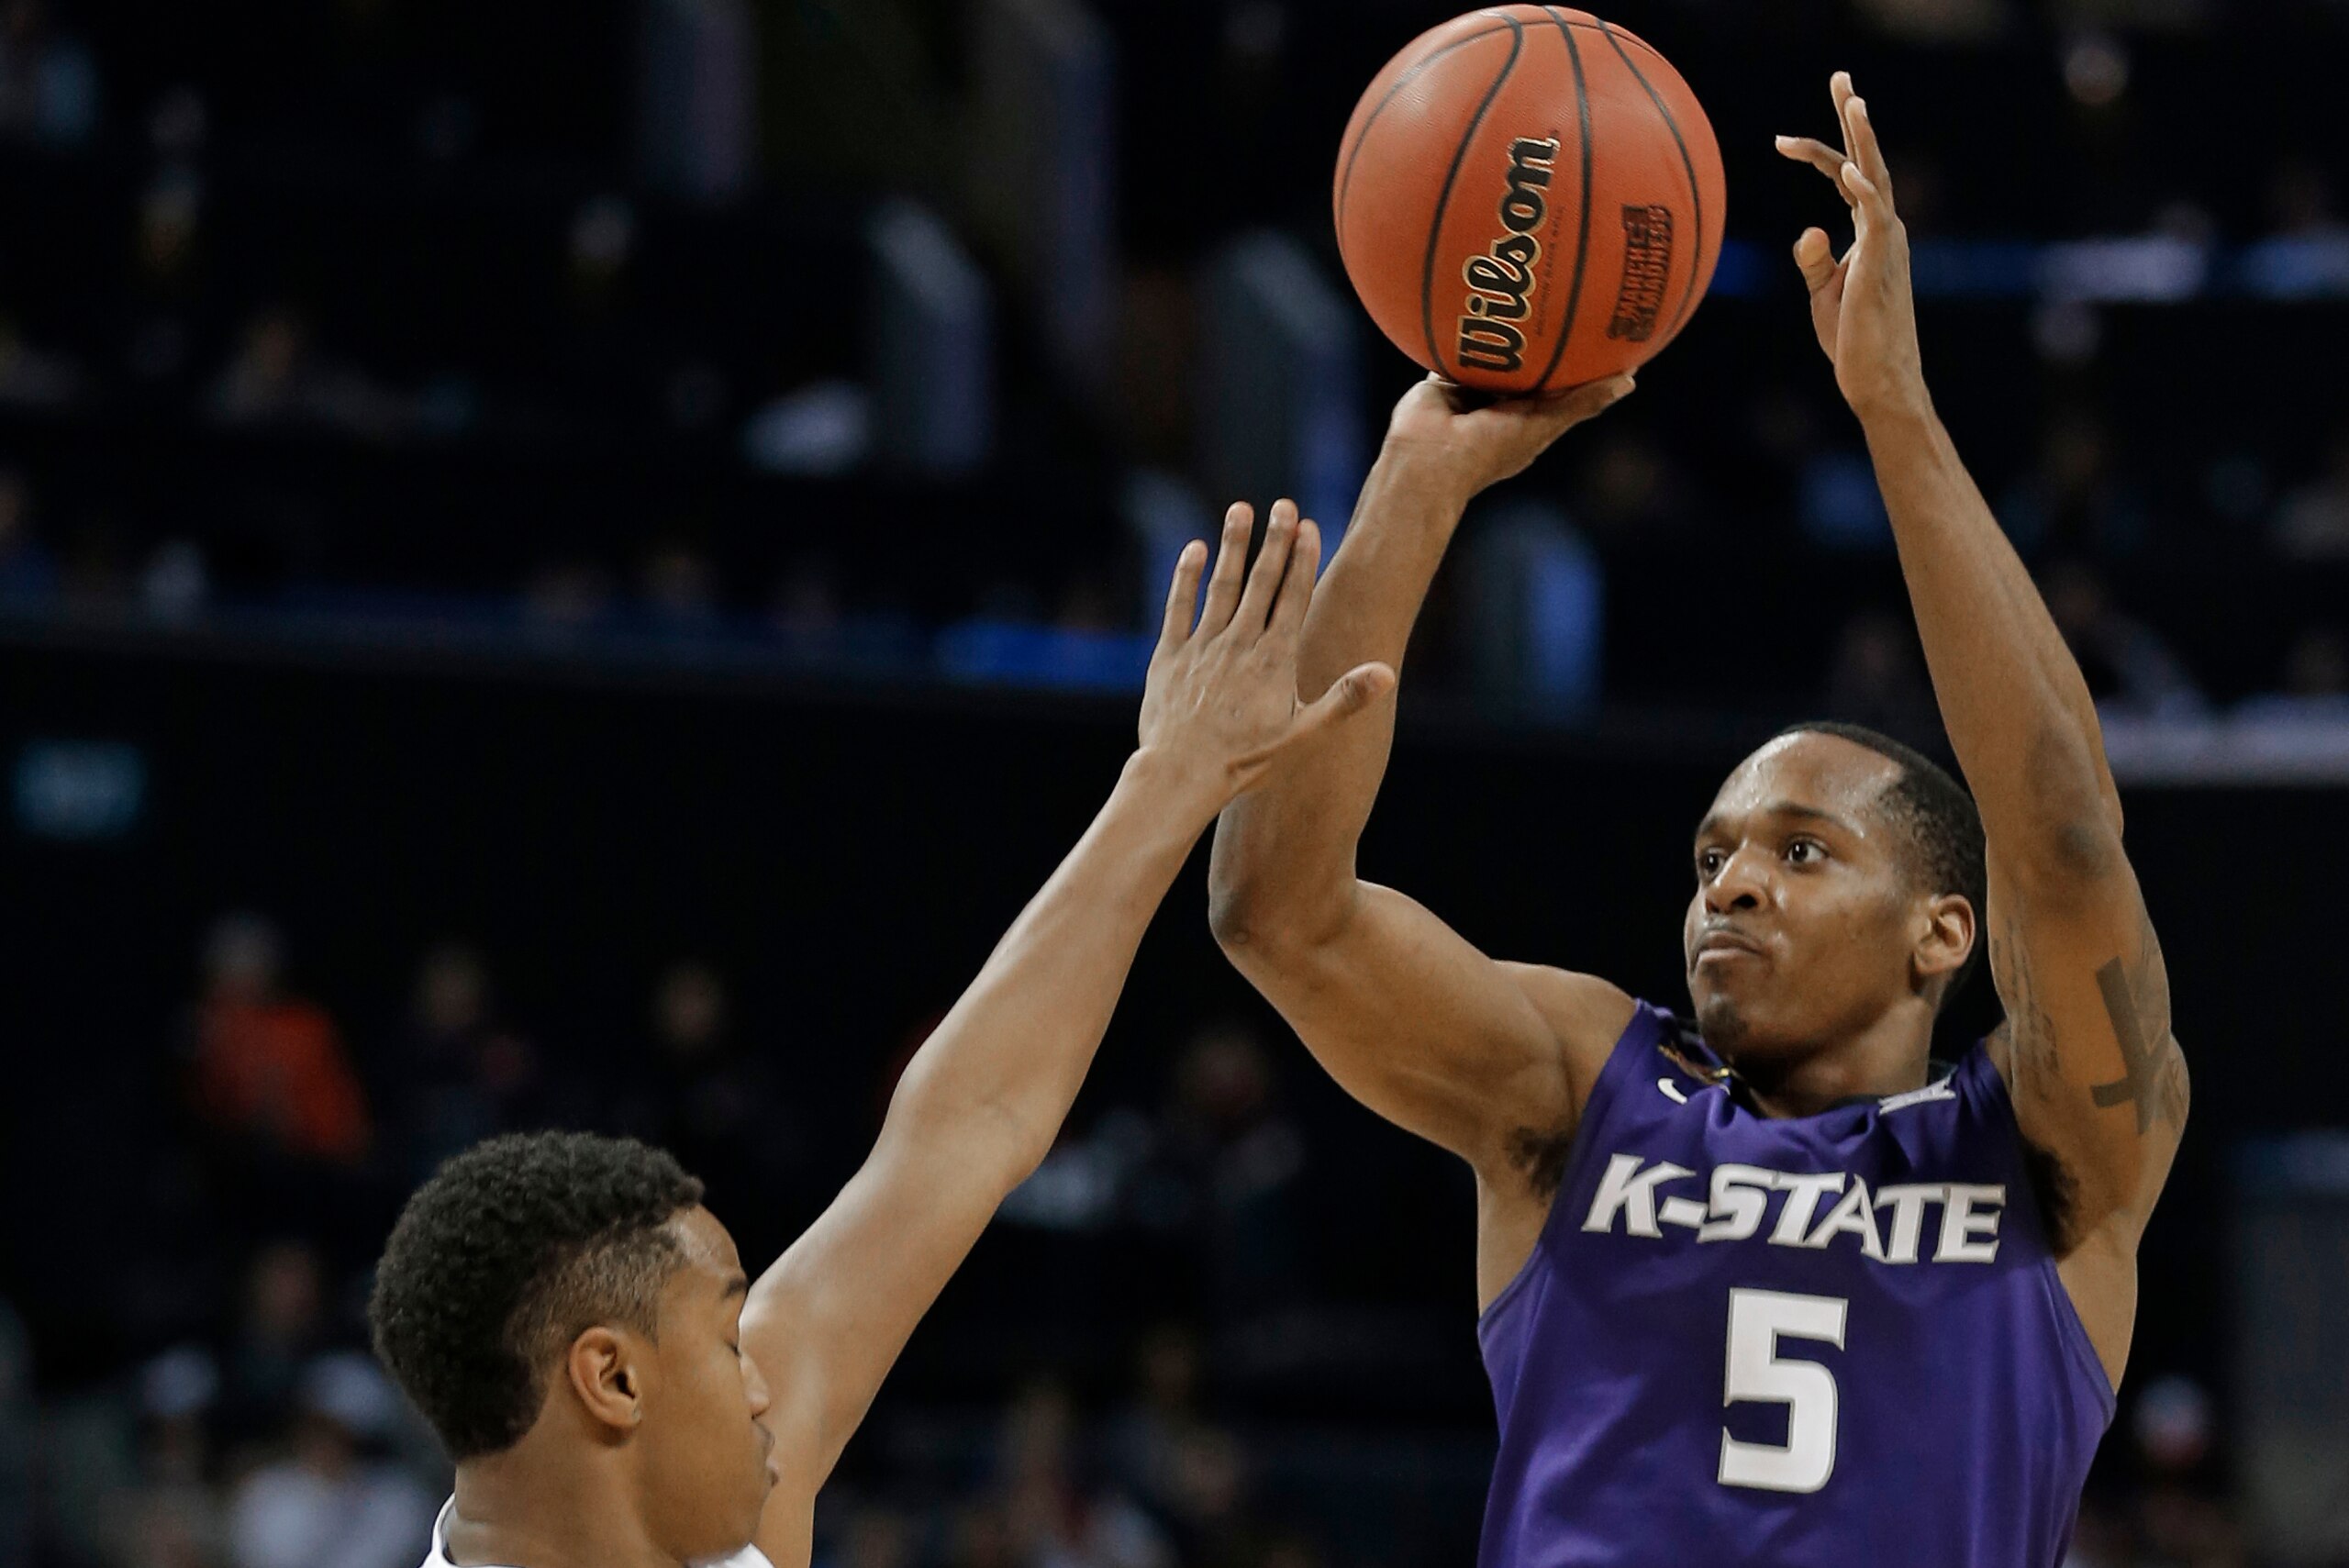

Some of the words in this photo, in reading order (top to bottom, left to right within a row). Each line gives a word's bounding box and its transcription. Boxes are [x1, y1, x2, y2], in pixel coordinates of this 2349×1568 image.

[1457, 137, 1560, 372] Wilson
[1581, 1152, 2007, 1264] K-STATE
[1717, 1286, 1848, 1494] 5
